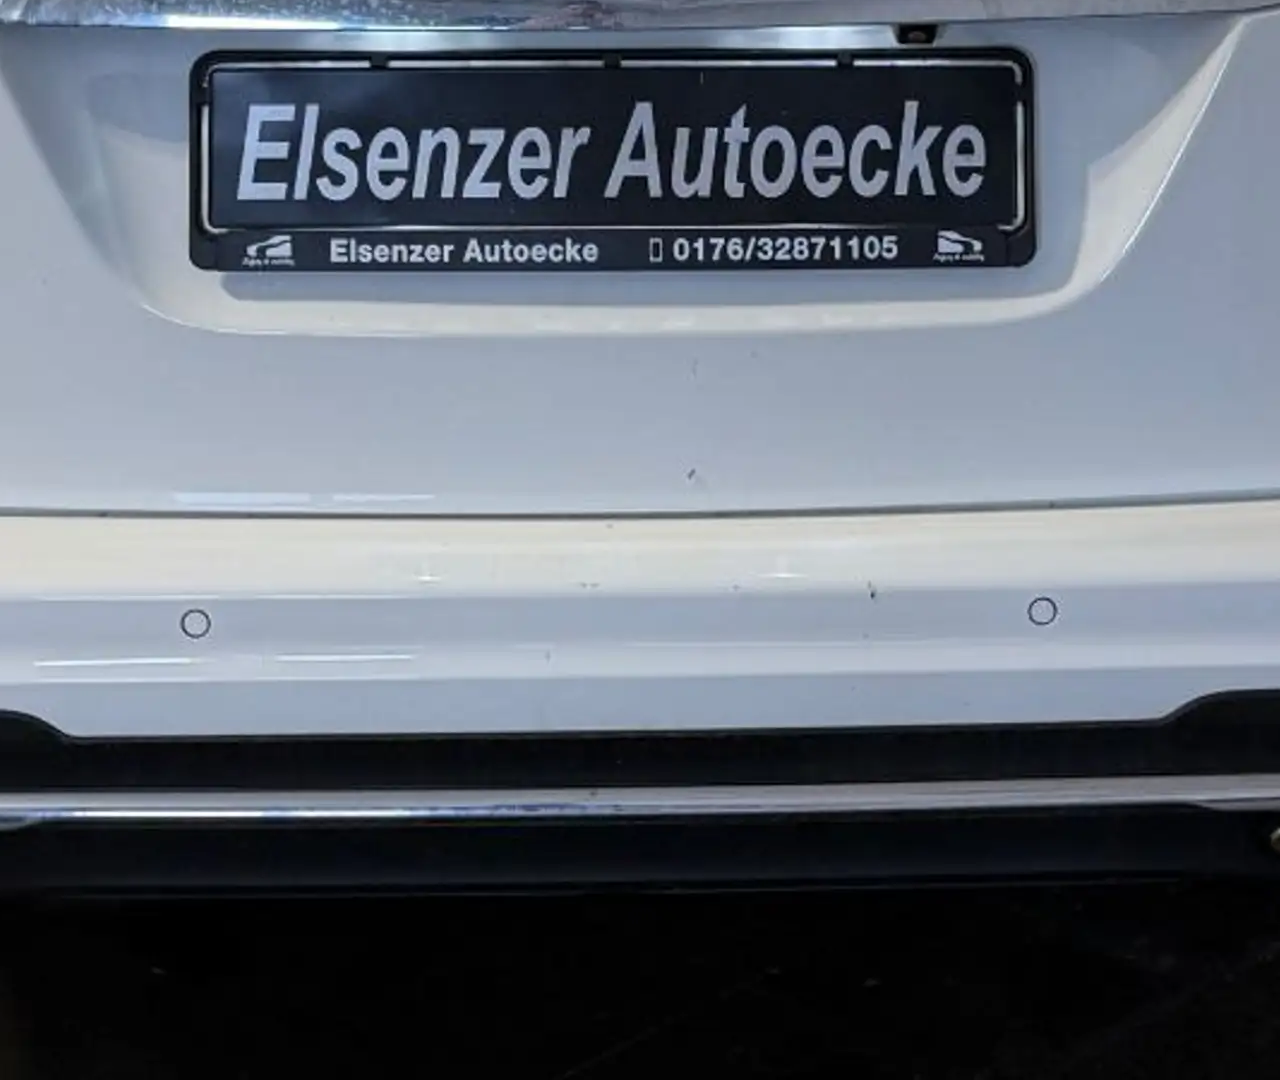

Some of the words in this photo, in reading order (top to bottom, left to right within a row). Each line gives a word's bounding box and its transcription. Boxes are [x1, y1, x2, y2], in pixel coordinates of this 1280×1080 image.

[236, 104, 591, 201] Elsenzer
[604, 100, 986, 199] Autoecke
[330, 237, 455, 264] Elsenzer
[462, 237, 600, 264] Autoecke
[673, 235, 899, 262] 0176/32871105
